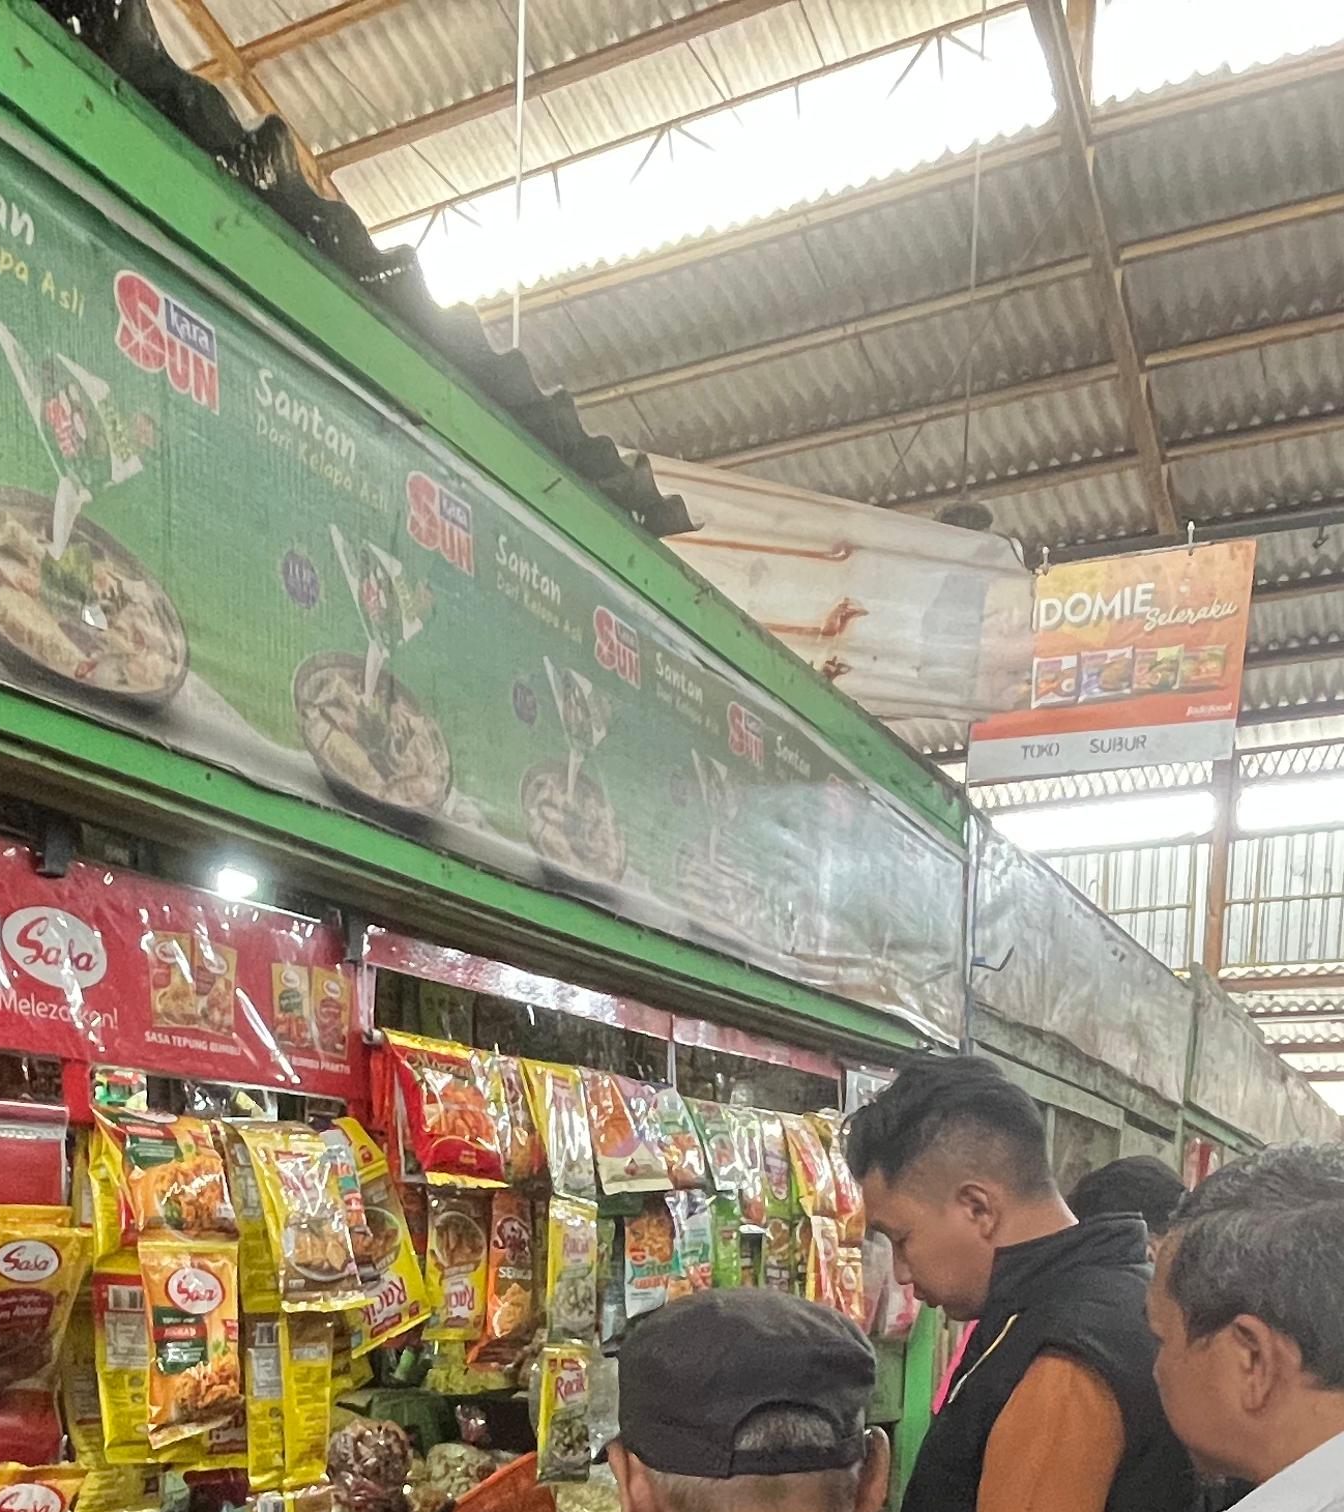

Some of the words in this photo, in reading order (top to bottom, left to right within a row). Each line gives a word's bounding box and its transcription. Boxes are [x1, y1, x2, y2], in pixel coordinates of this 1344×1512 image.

[41, 271, 86, 317] Asli
[113, 270, 220, 415] SUN
[256, 369, 356, 468] Santan
[257, 414, 293, 450] Dari
[298, 443, 353, 490] Kelapa
[406, 470, 474, 577] SUN
[495, 534, 561, 606] Santan
[1032, 582, 1156, 632] DOMIE
[1144, 598, 1239, 633] Seleraku
[1088, 735, 1148, 755] SUBUR
[16, 916, 97, 973] Sasa
[144, 1031, 170, 1046] SASA
[2, 1245, 50, 1273] Sasa
